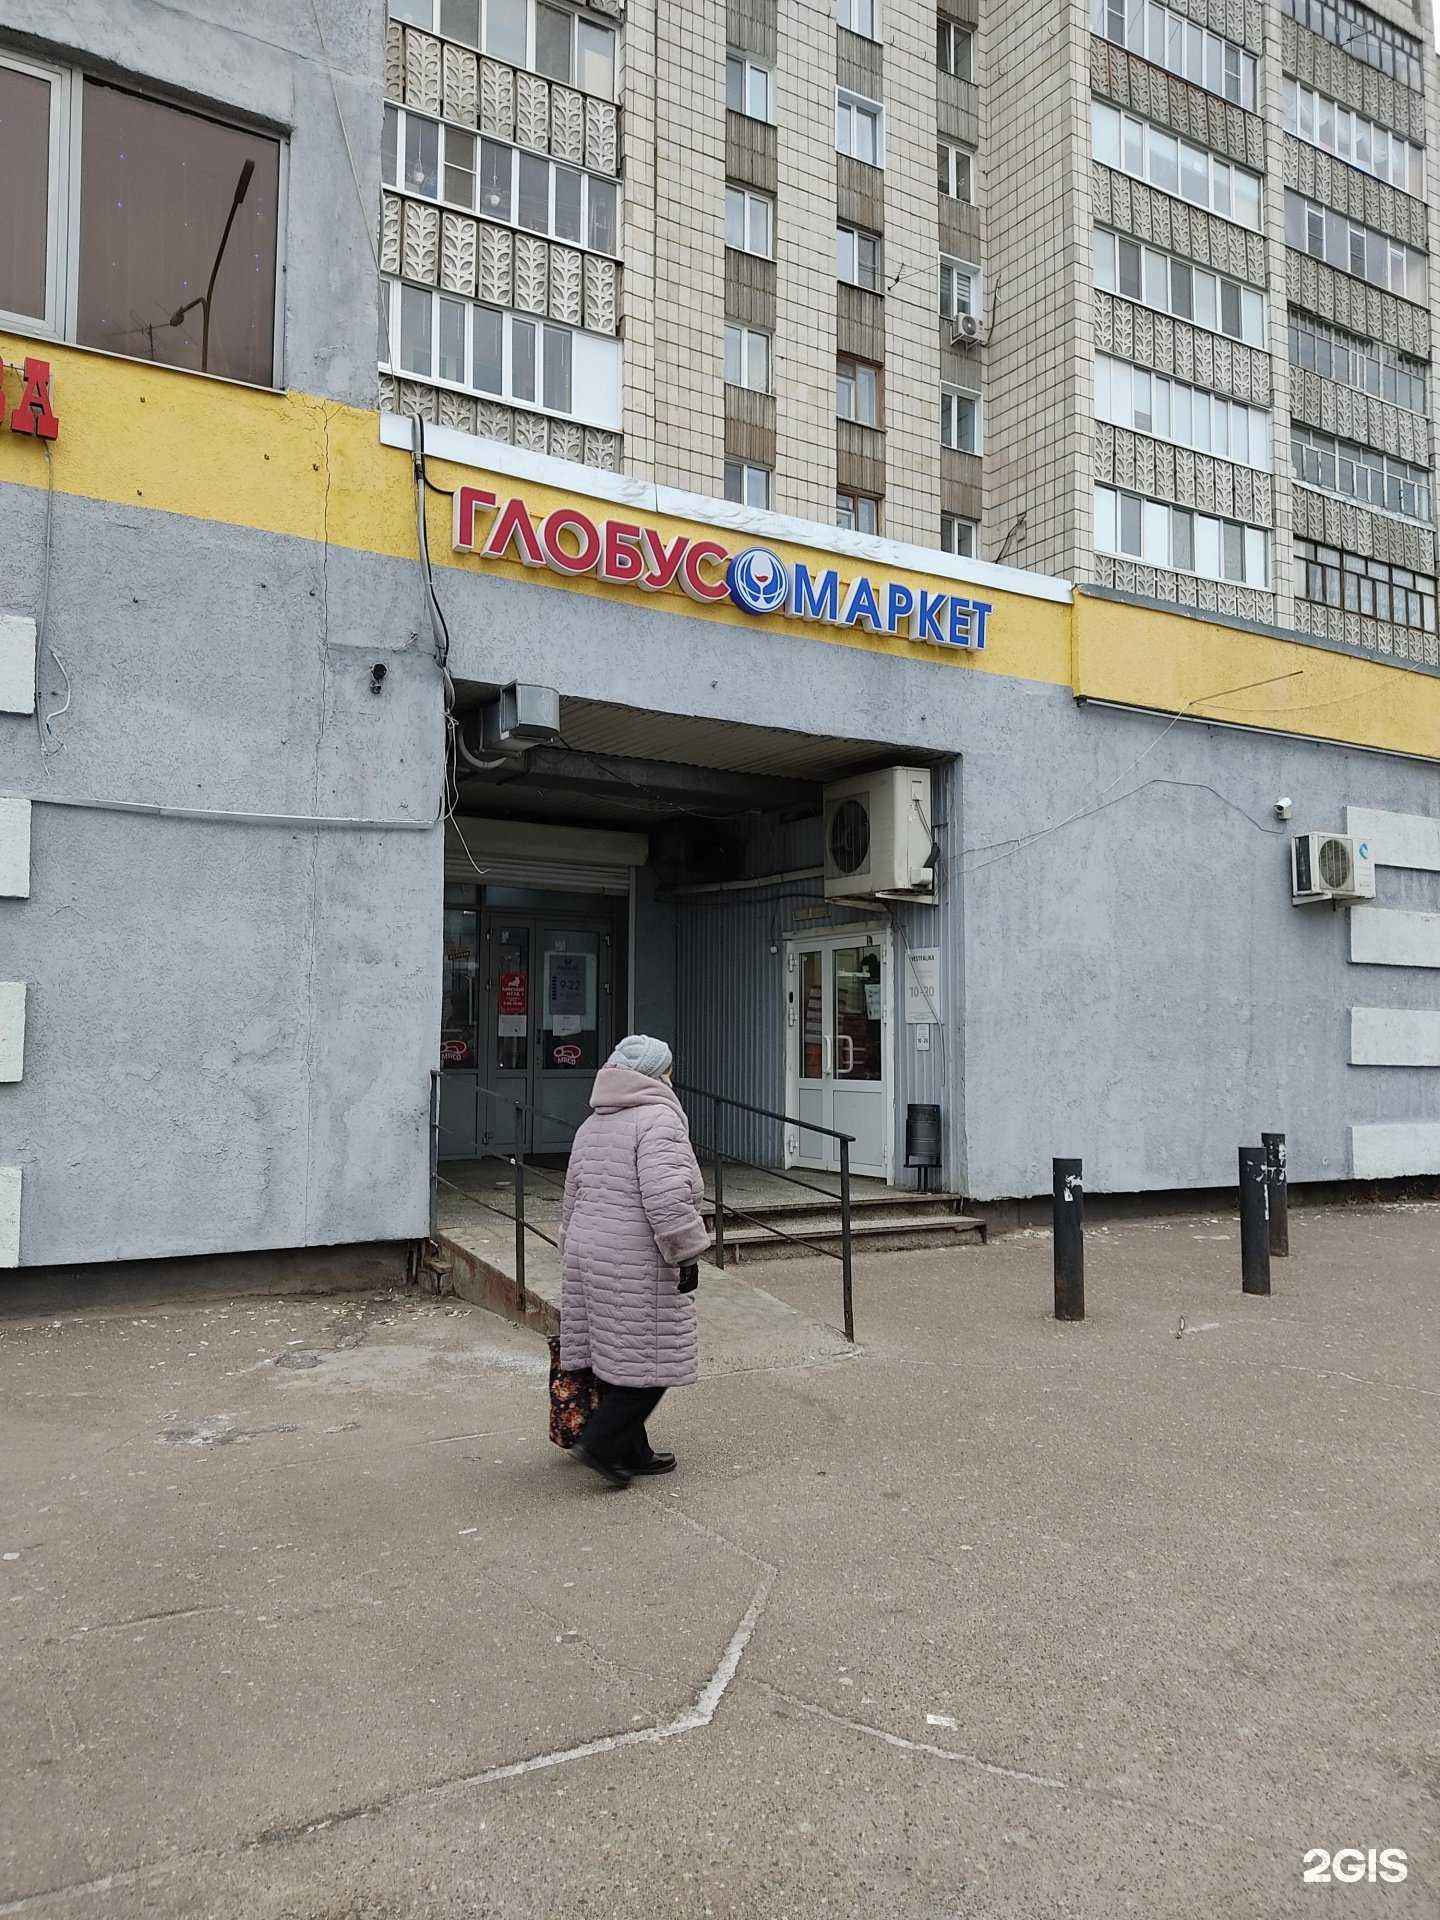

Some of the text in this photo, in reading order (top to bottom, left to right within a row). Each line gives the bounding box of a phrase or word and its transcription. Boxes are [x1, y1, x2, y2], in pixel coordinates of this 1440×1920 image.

[0, 356, 59, 441] А
[453, 487, 993, 651] ГЛОБУС МАРКЕТ
